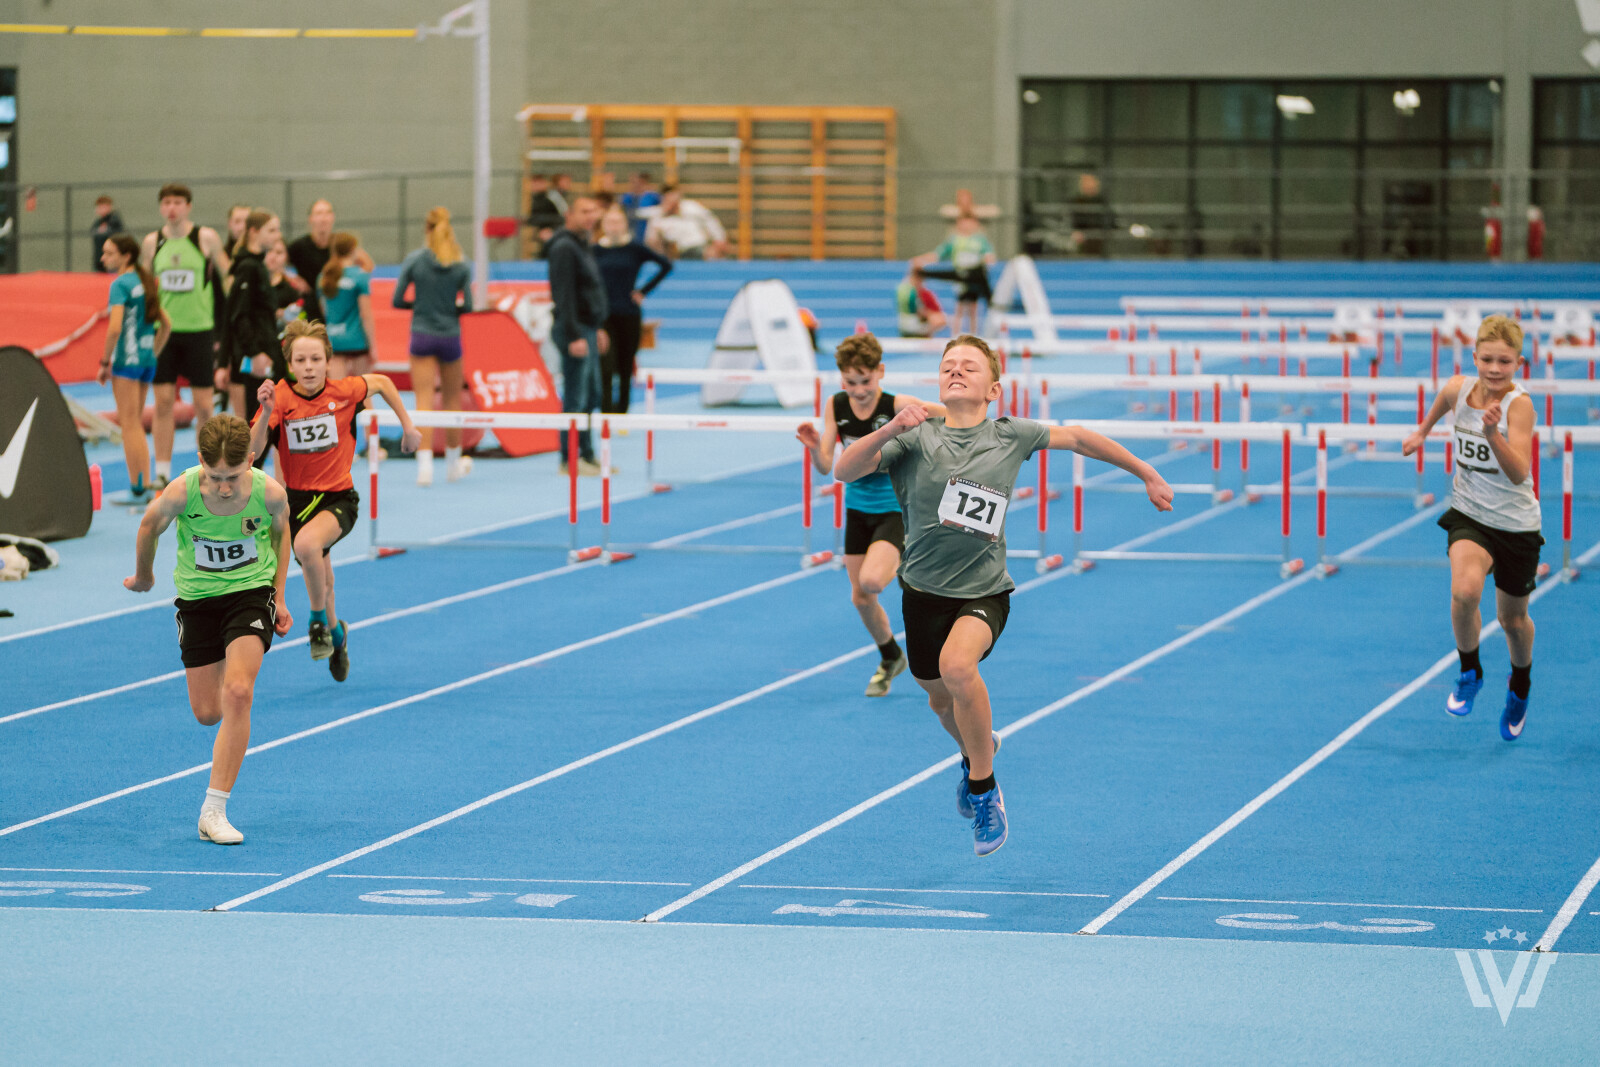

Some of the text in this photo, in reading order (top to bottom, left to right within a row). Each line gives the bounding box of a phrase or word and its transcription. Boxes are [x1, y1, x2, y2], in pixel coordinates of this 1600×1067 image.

[292, 423, 330, 444] 132
[1458, 437, 1490, 462] 158
[956, 491, 998, 525] 121
[203, 543, 245, 563] 118
[771, 899, 990, 919] 4
[1215, 912, 1436, 934] 3
